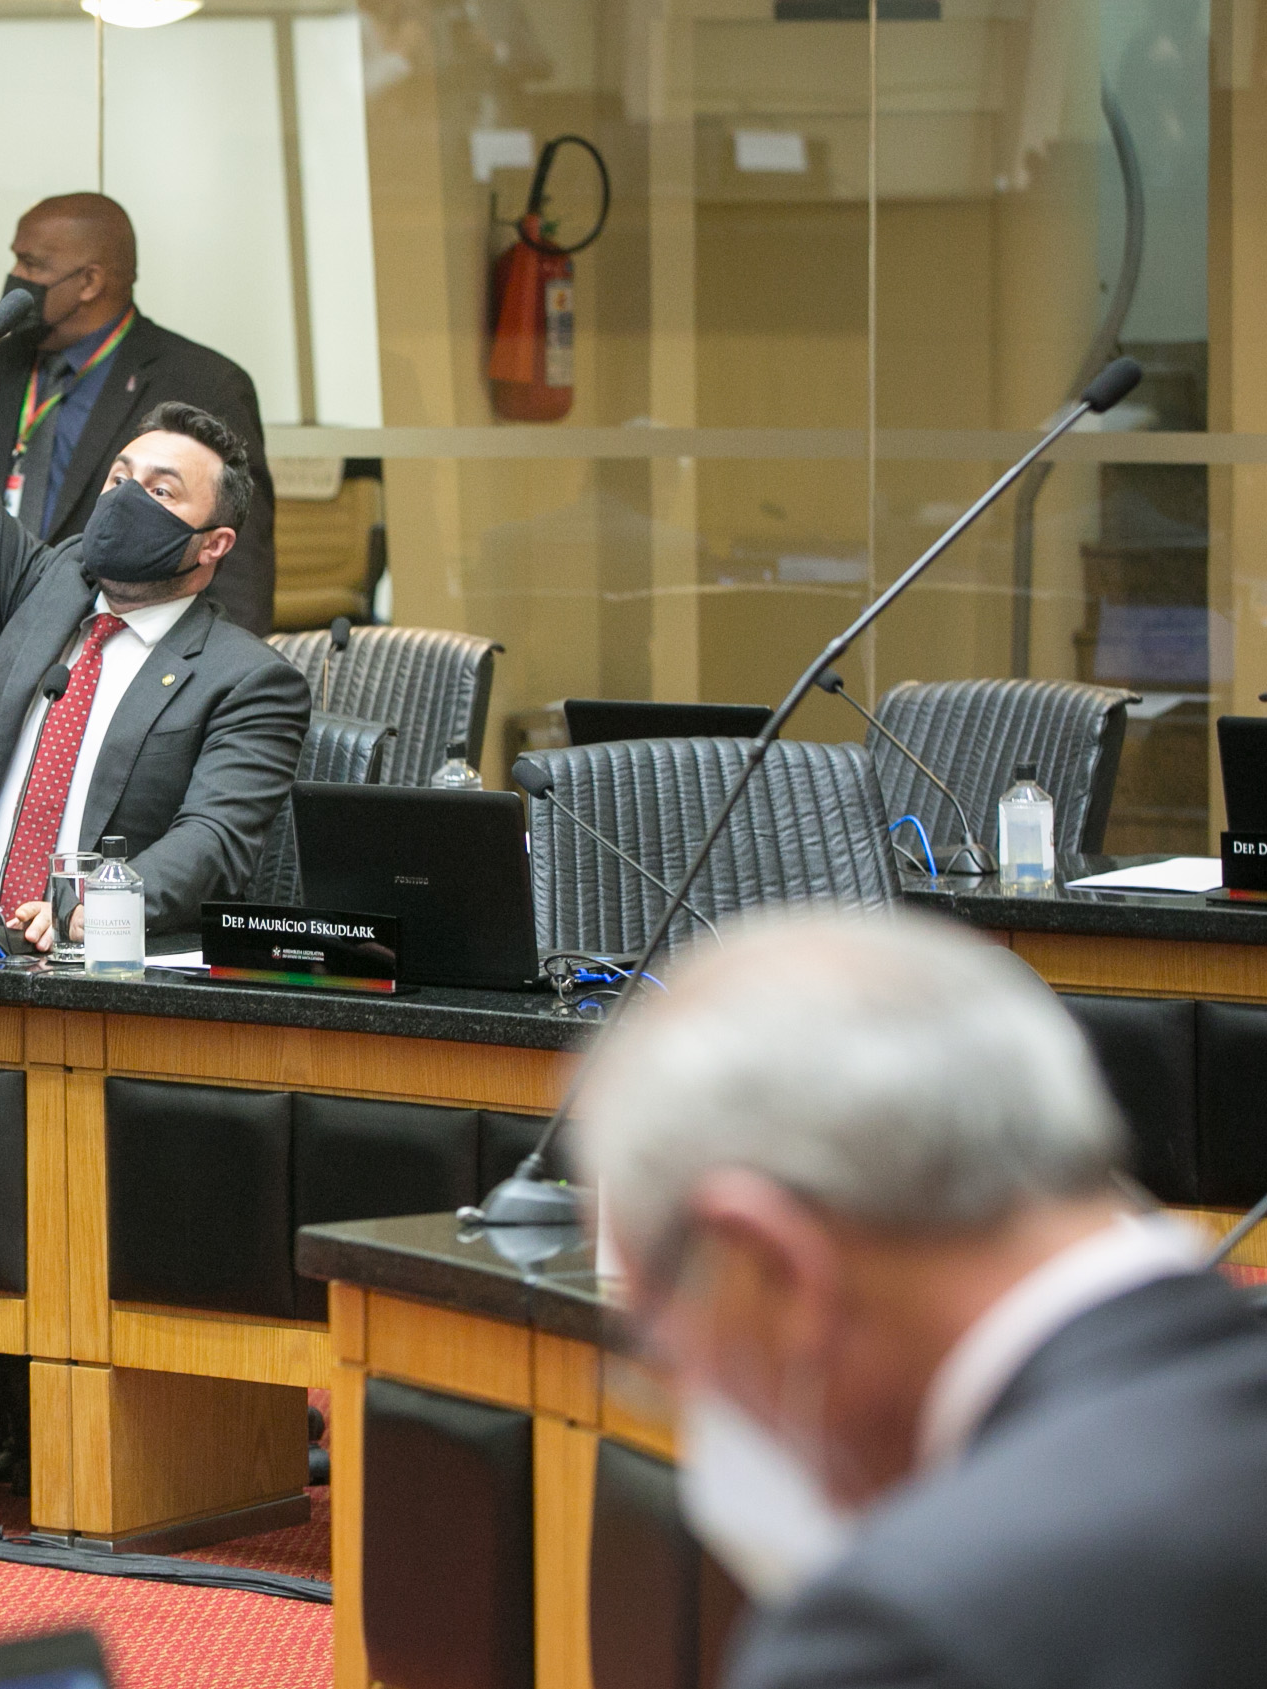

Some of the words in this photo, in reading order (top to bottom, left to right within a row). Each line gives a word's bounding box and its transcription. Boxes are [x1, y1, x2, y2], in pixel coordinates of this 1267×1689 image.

[1233, 840, 1255, 855] DEP.
[222, 914, 245, 929] DEP.
[248, 916, 307, 934] MAURÍCIO
[310, 920, 376, 939] ESKUDLARK
